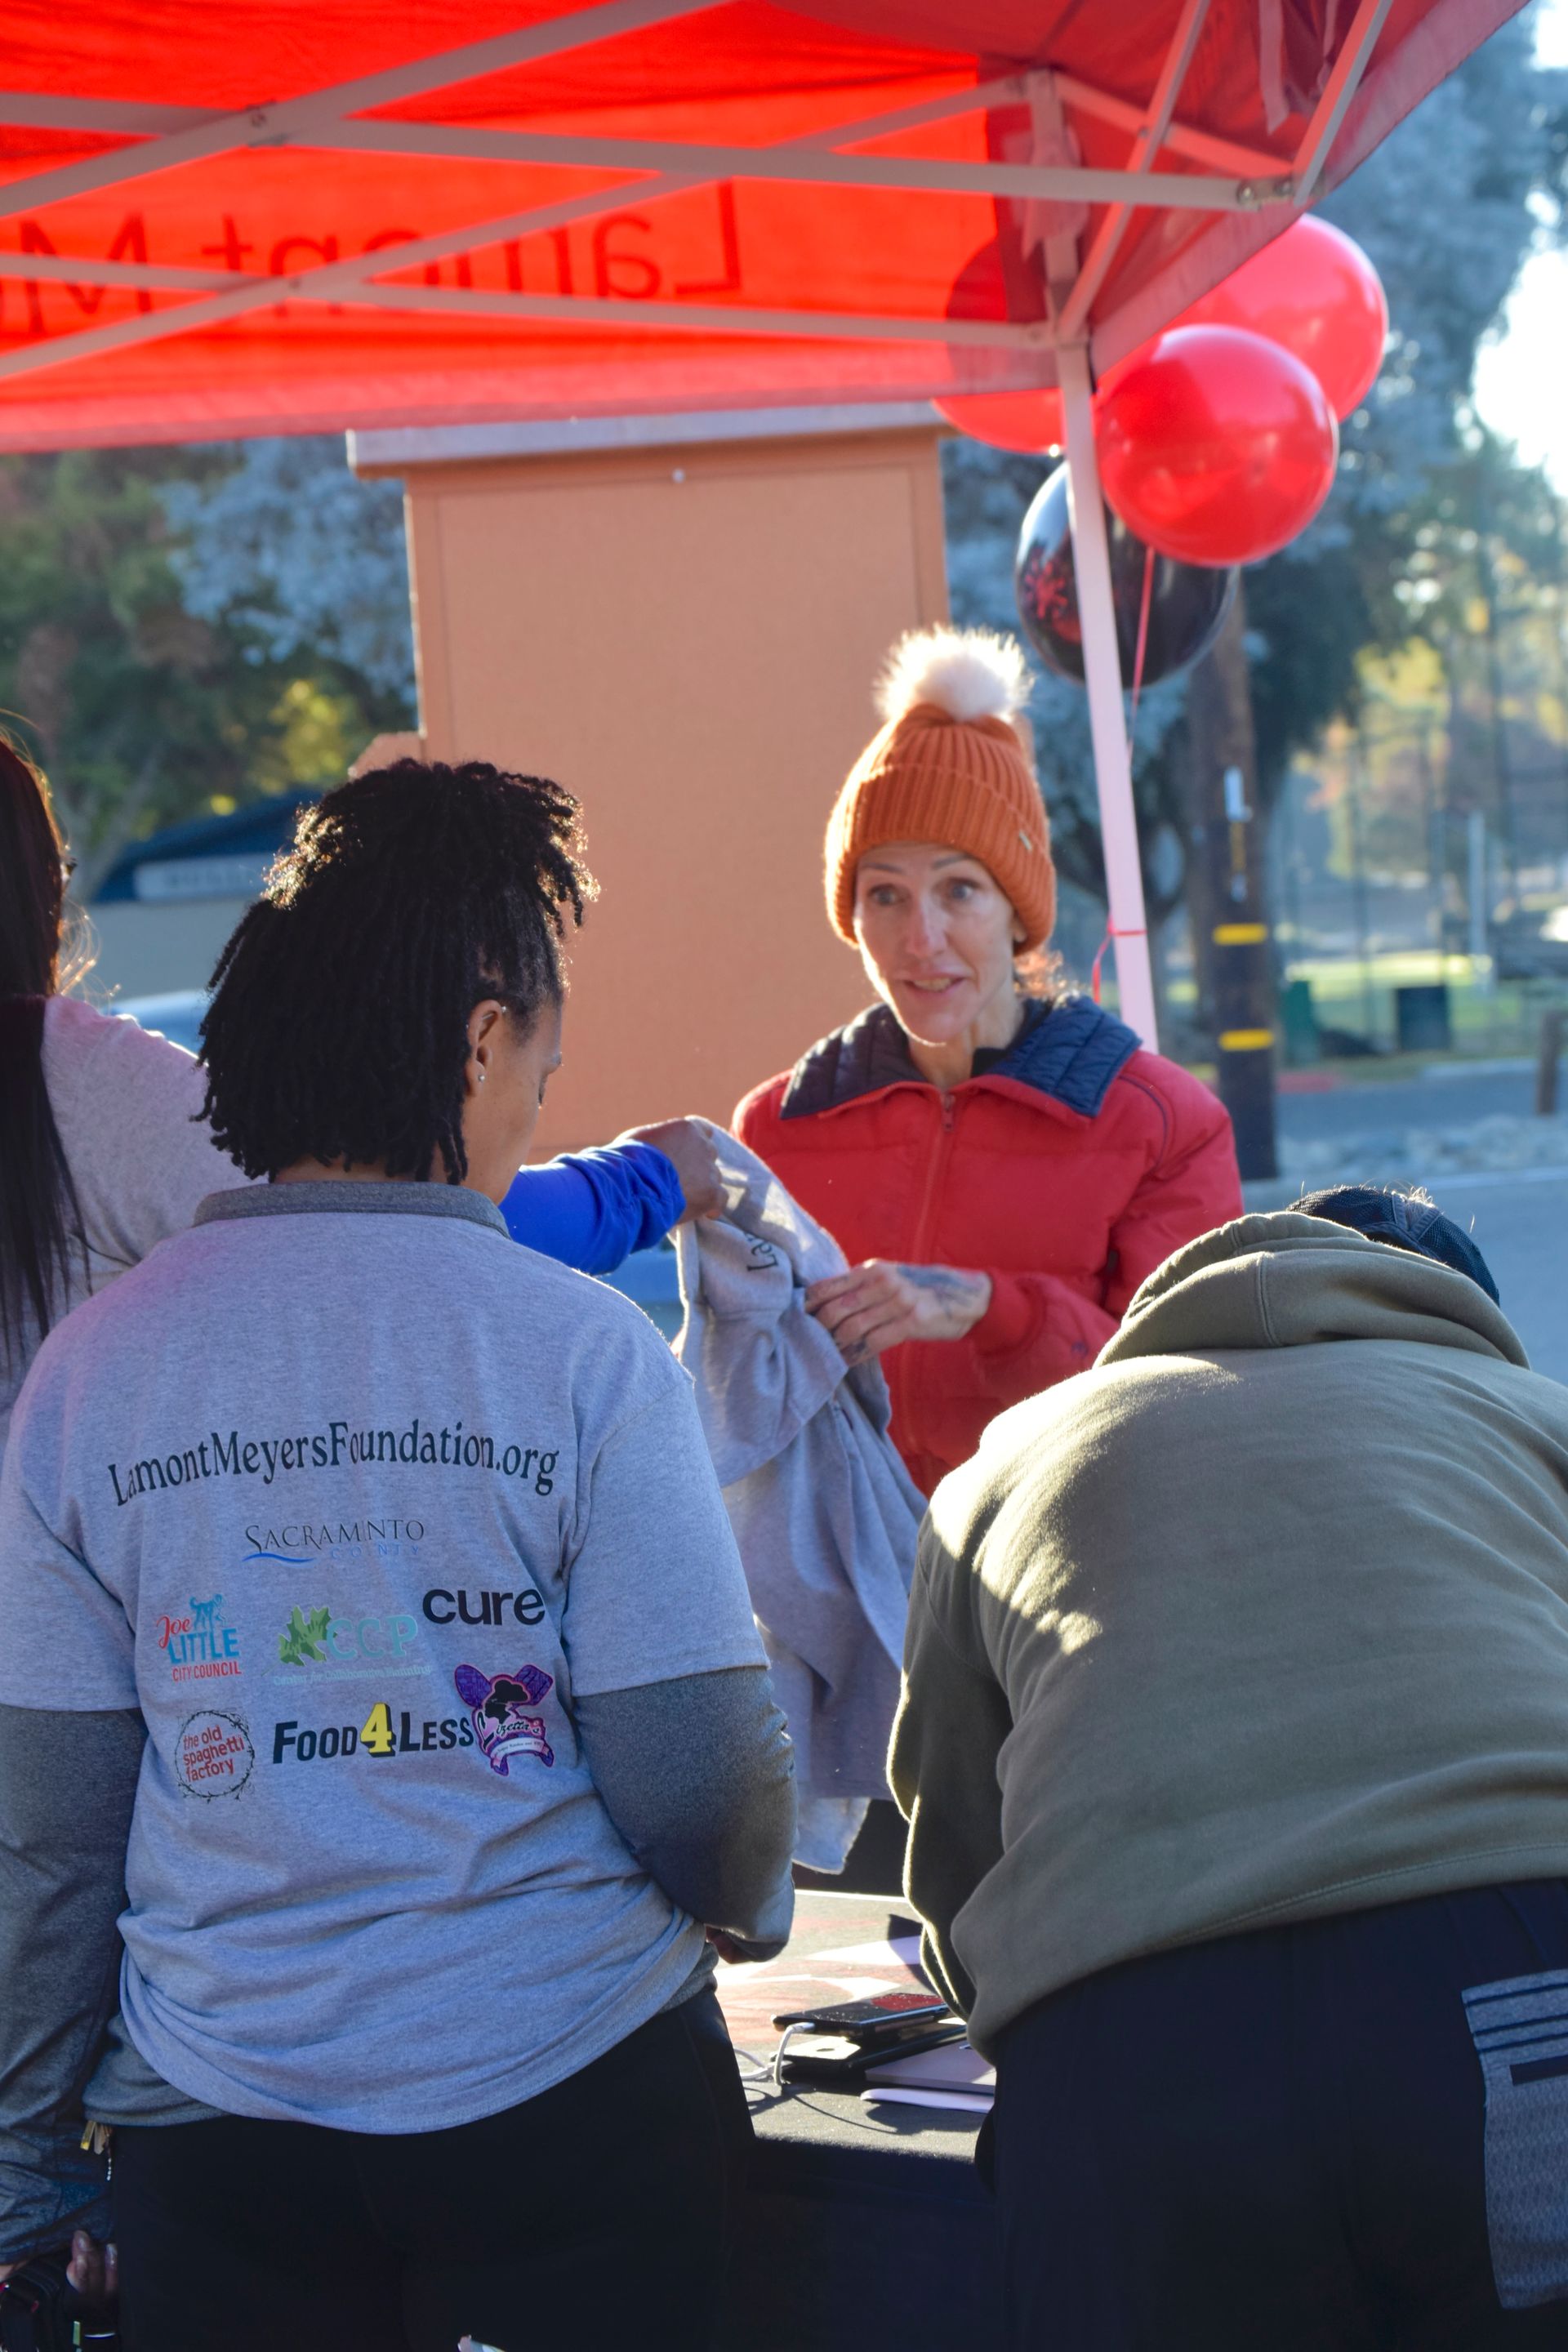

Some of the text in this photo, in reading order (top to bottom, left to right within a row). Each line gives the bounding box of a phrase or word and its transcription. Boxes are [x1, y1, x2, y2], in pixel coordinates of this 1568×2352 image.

[108, 1419, 559, 1506] LamontMeyersFoundation.org
[245, 1519, 425, 1554] SACRAMNTO
[331, 1541, 419, 1559] CONTY
[422, 1588, 546, 1625] cure
[156, 1615, 191, 1649] Joe
[168, 1628, 240, 1664] LITTLE
[327, 1615, 418, 1659] CCP
[172, 1661, 242, 1682] CITY COUNCIL
[183, 1725, 222, 1750] the old
[183, 1735, 244, 1767] spaghetti
[185, 1758, 234, 1783] factory
